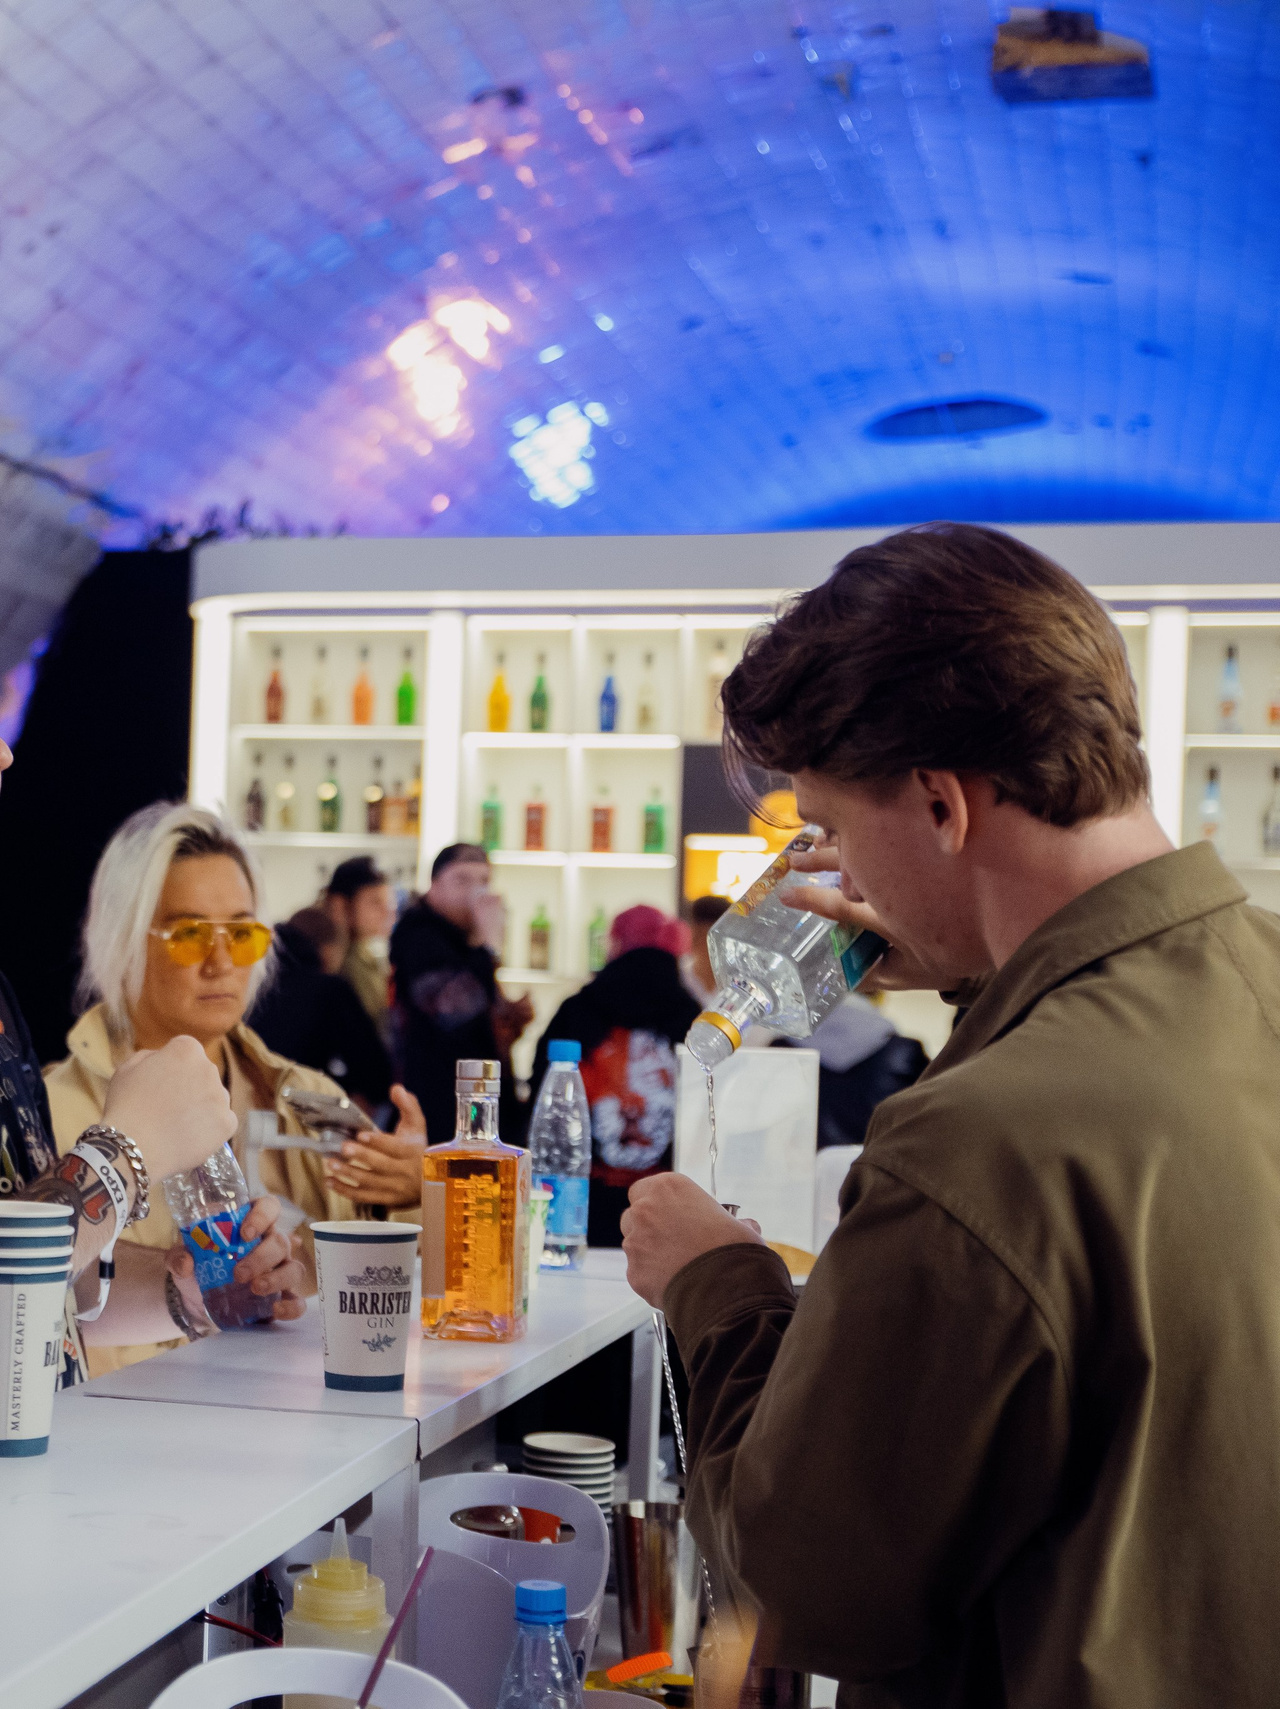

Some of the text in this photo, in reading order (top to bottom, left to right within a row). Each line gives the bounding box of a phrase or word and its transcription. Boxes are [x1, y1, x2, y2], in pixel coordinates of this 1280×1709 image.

[100, 1165, 124, 1204] EXPO
[367, 1317, 395, 1329] GIN
[10, 1293, 27, 1431] MASTERLY CRAFTED
